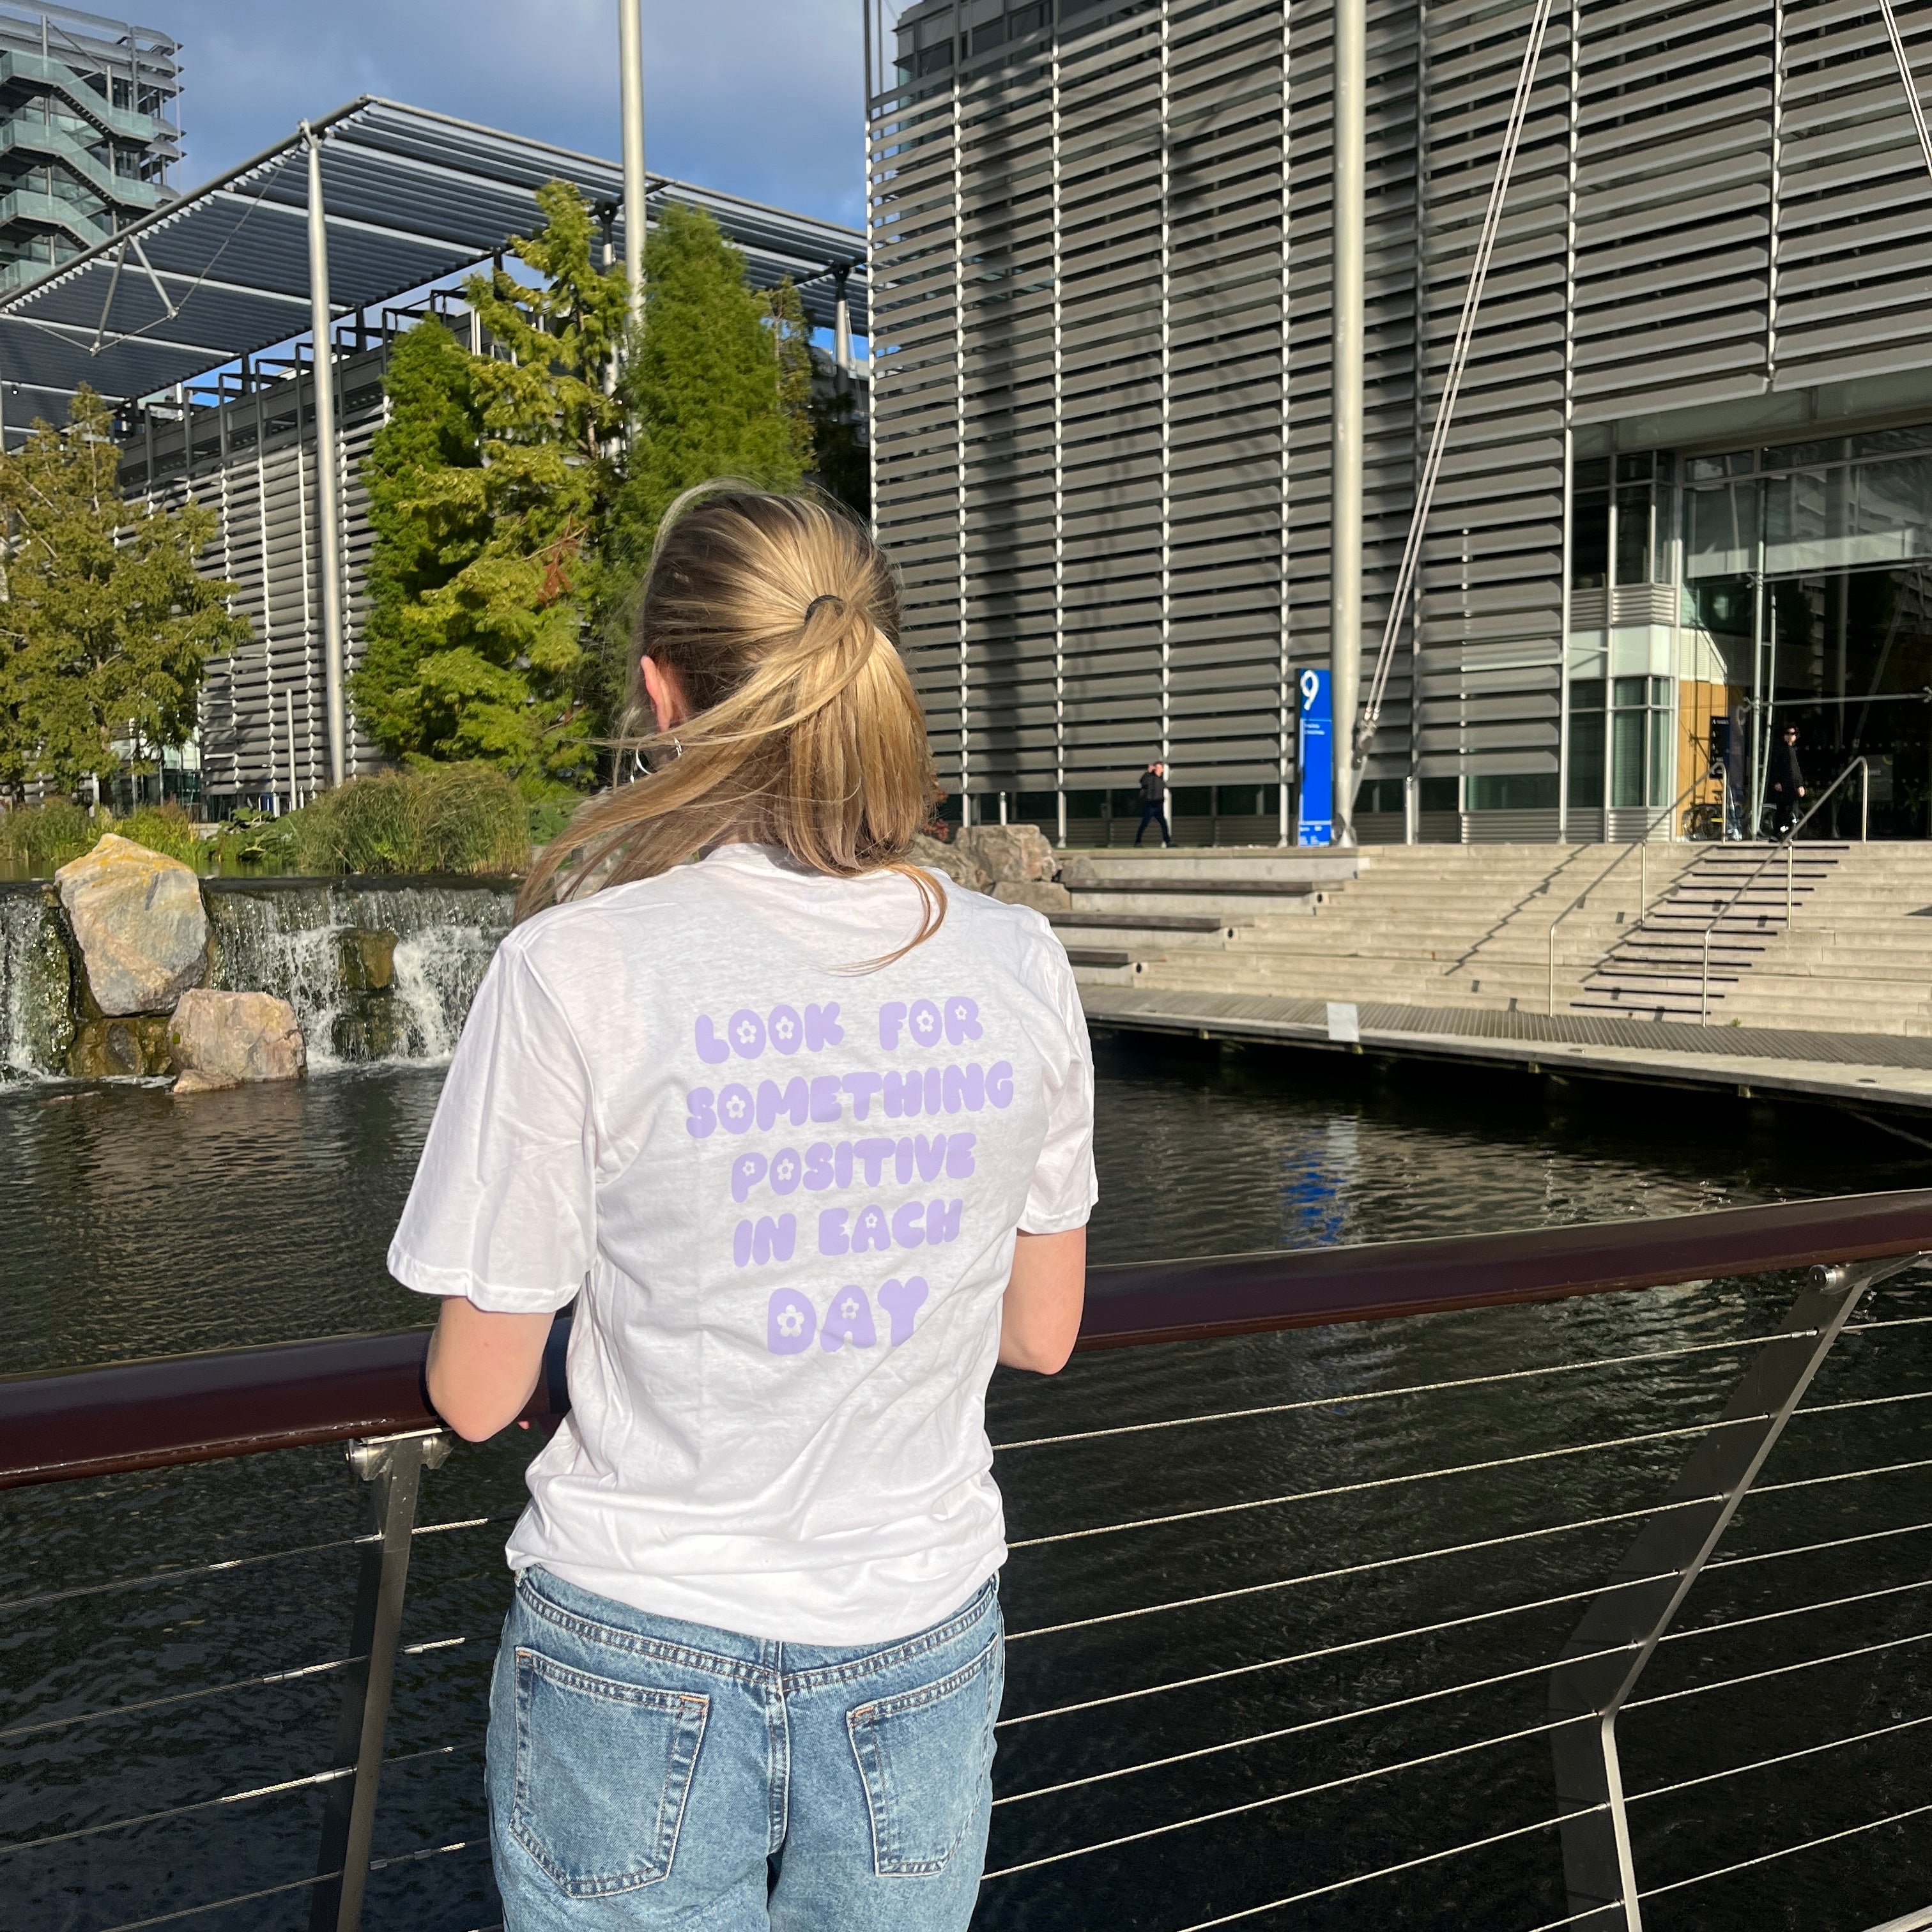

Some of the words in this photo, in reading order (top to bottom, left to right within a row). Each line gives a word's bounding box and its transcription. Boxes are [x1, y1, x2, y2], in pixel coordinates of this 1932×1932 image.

[1300, 670, 1319, 710] 9
[695, 1002, 844, 1064] LOOK
[879, 996, 983, 1051] FOR
[686, 1061, 1014, 1138] SOMETHING
[731, 1133, 977, 1203] POSITIVE
[733, 1213, 797, 1268] IN
[818, 1199, 963, 1256] EACH
[767, 1276, 929, 1355] DAY
